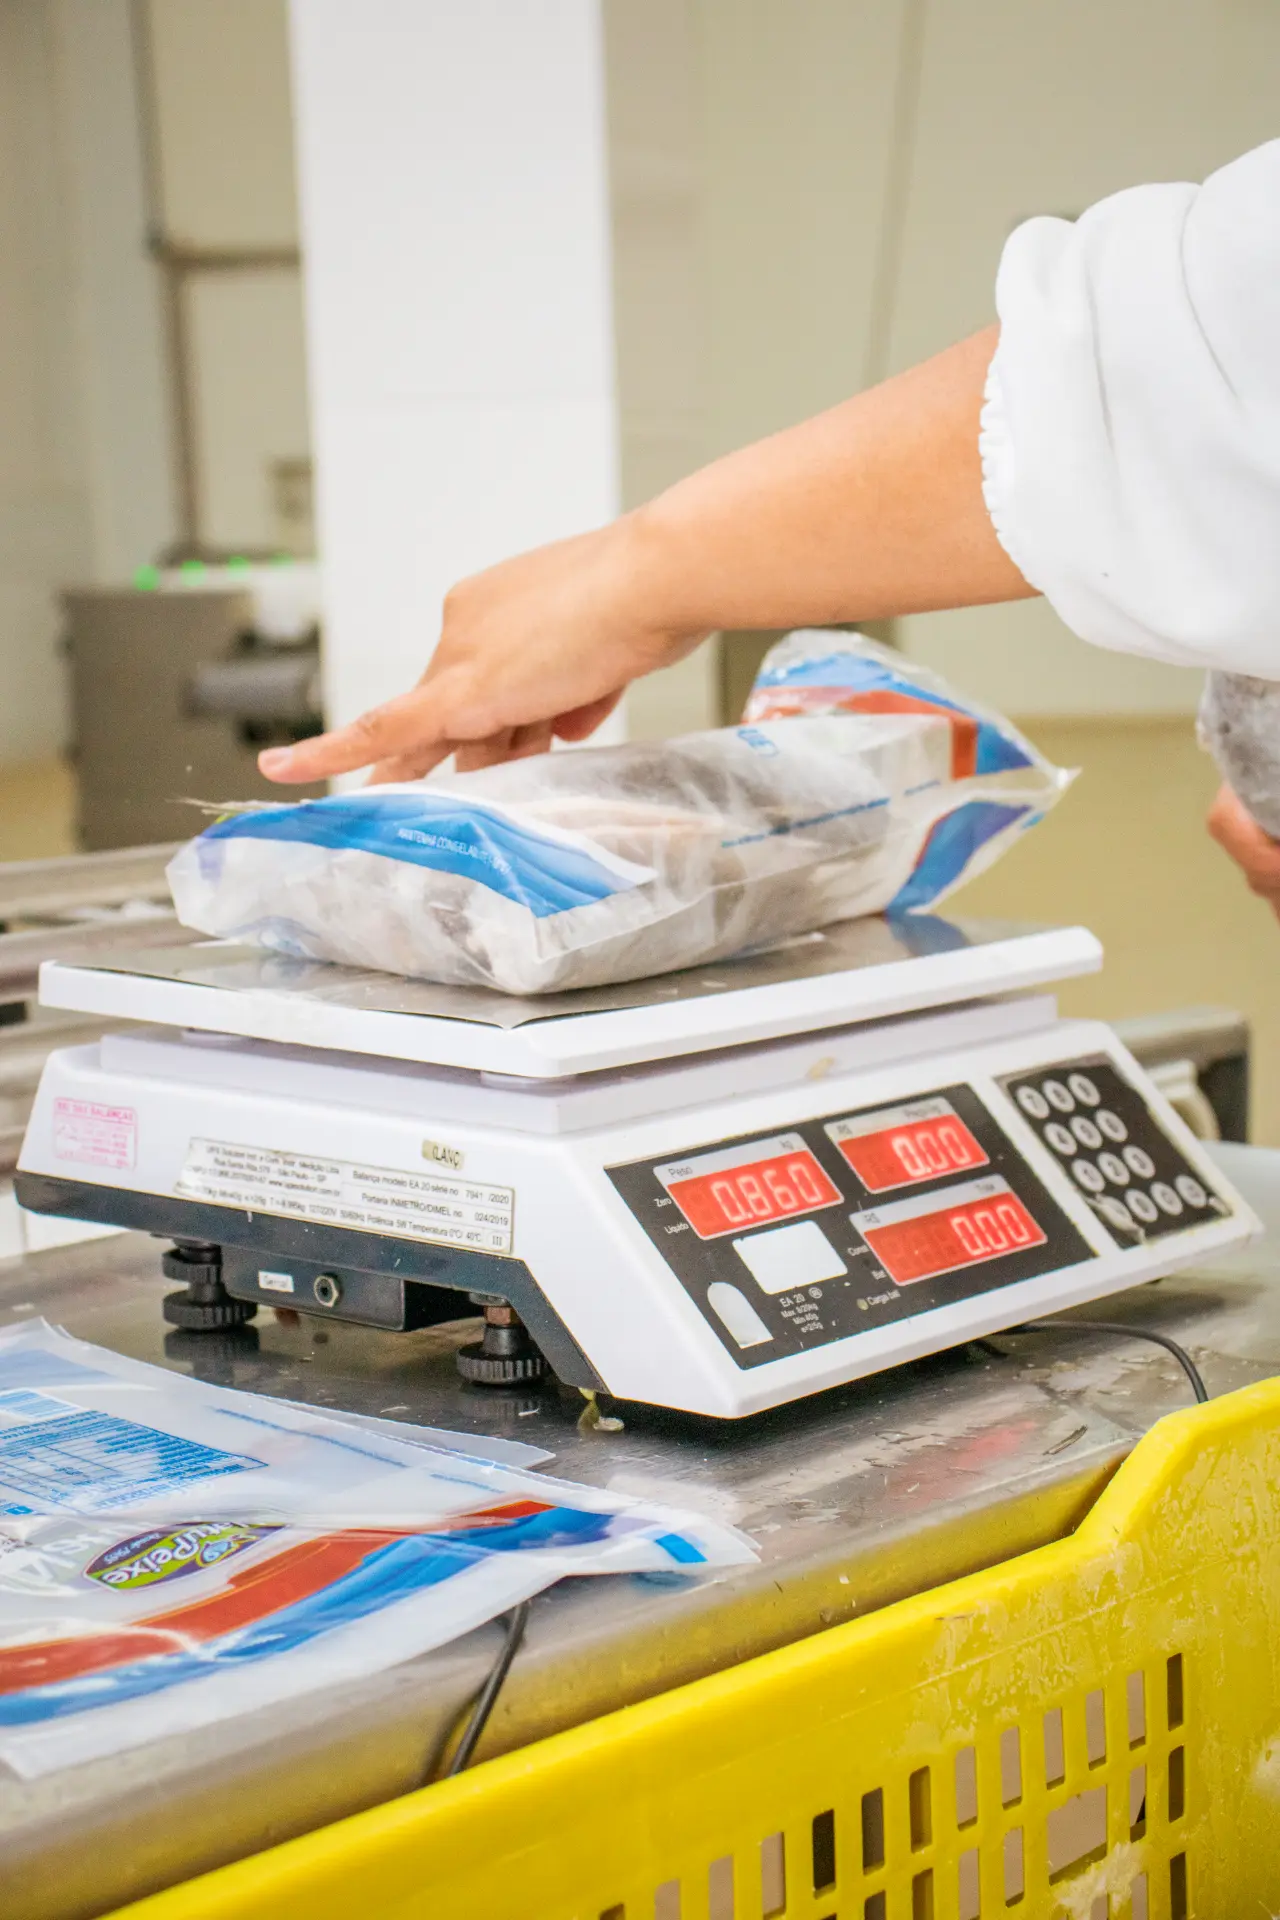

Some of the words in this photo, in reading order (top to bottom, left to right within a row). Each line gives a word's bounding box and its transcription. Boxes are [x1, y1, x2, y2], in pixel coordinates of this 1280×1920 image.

[891, 1125, 973, 1178] 0.00
[408, 1179, 420, 1189] EA
[420, 1181, 432, 1192] 20
[667, 1166, 694, 1178] Peso
[653, 1197, 673, 1208] Zero
[709, 1162, 824, 1224] 0.860
[949, 1203, 1032, 1257] 0.00
